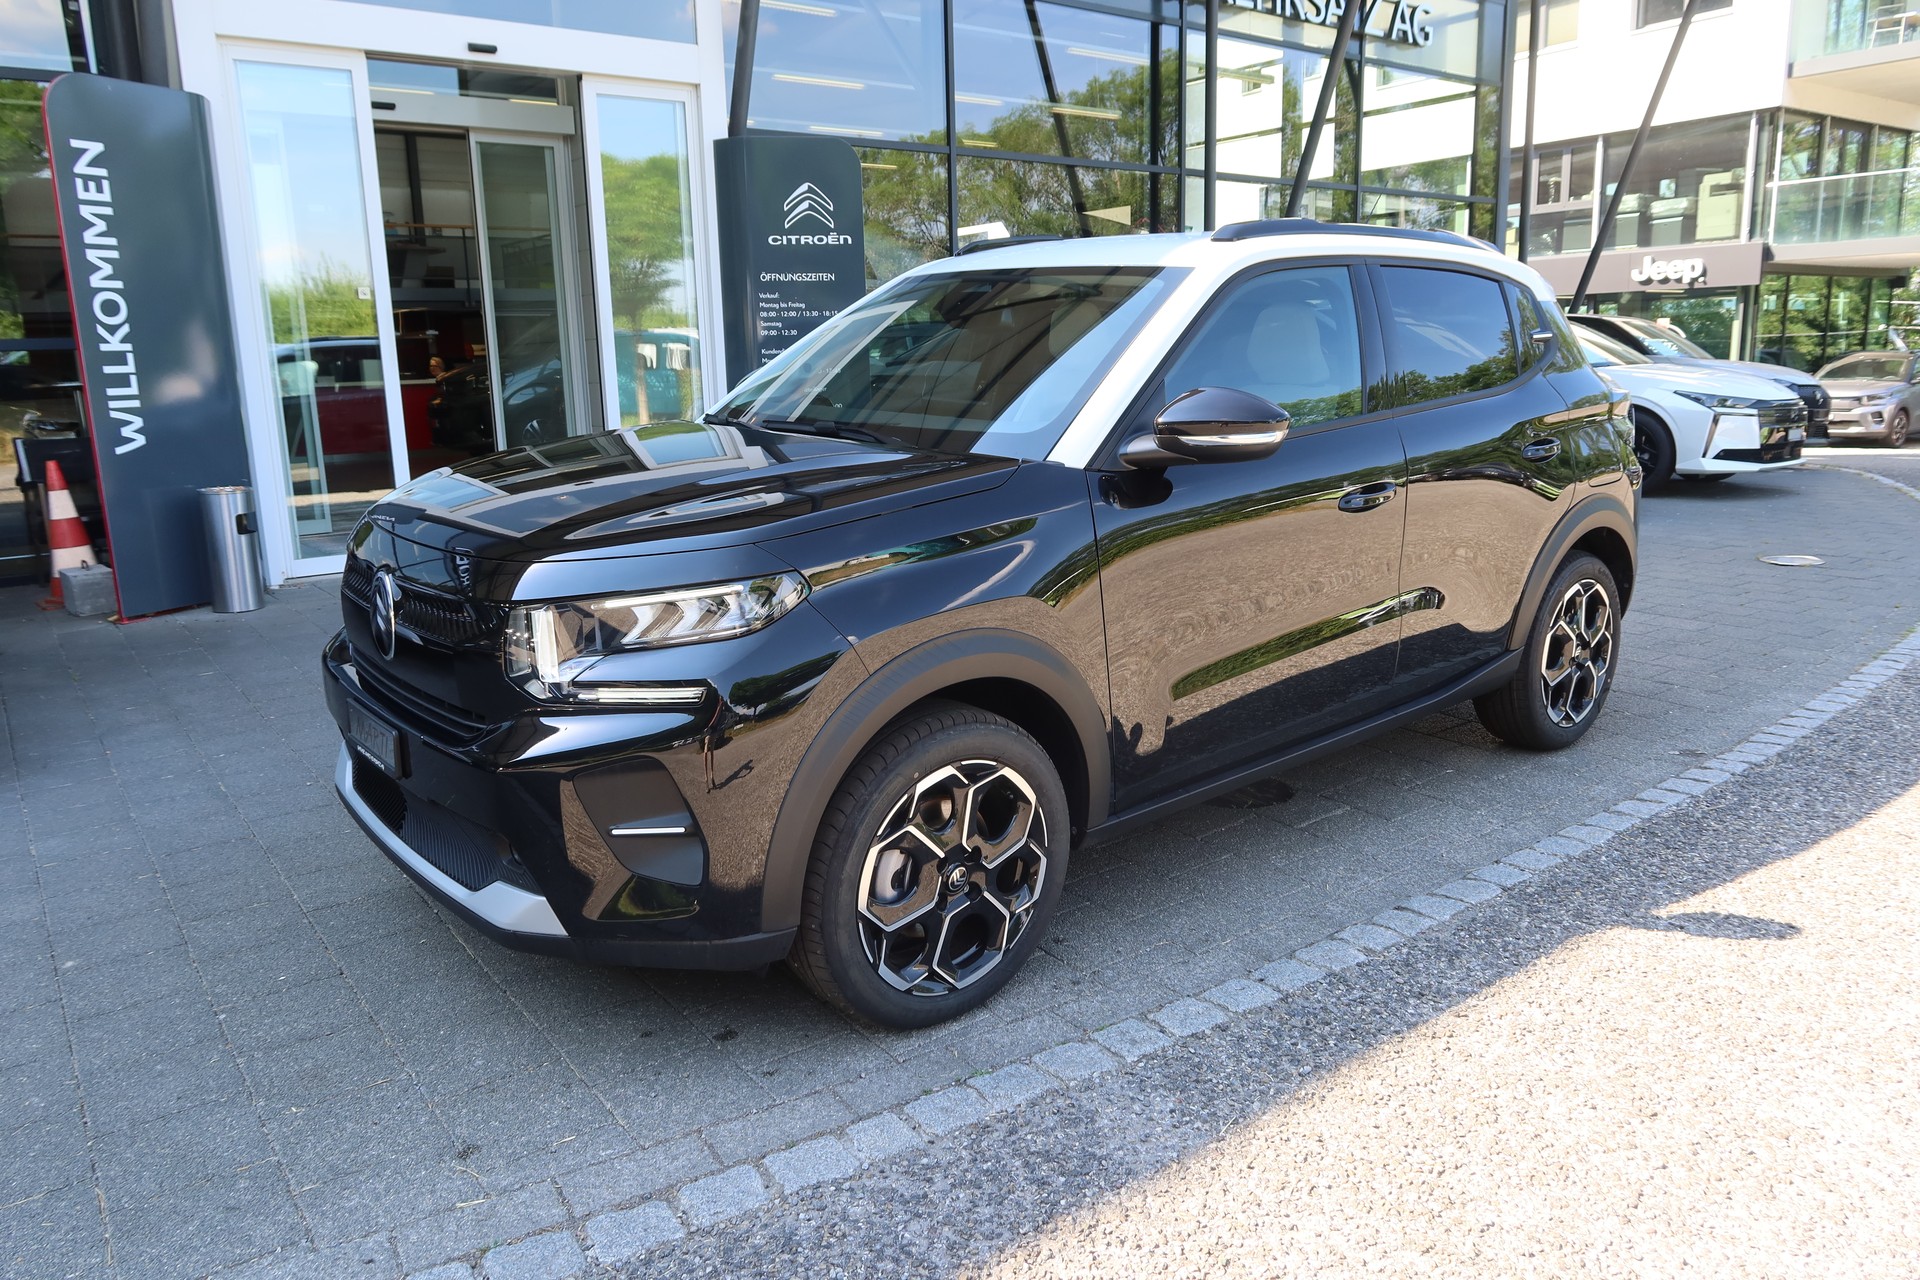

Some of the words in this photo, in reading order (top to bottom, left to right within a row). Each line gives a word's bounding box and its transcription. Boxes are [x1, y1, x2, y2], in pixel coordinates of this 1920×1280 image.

[1391, 2, 1434, 47] AG
[767, 232, 852, 245] CITROËN
[759, 271, 836, 282] ÖFFNUNGSZEITEN
[69, 138, 147, 455] WILLKOMMEN
[788, 301, 805, 309] Freitag
[760, 320, 782, 328] Samstag
